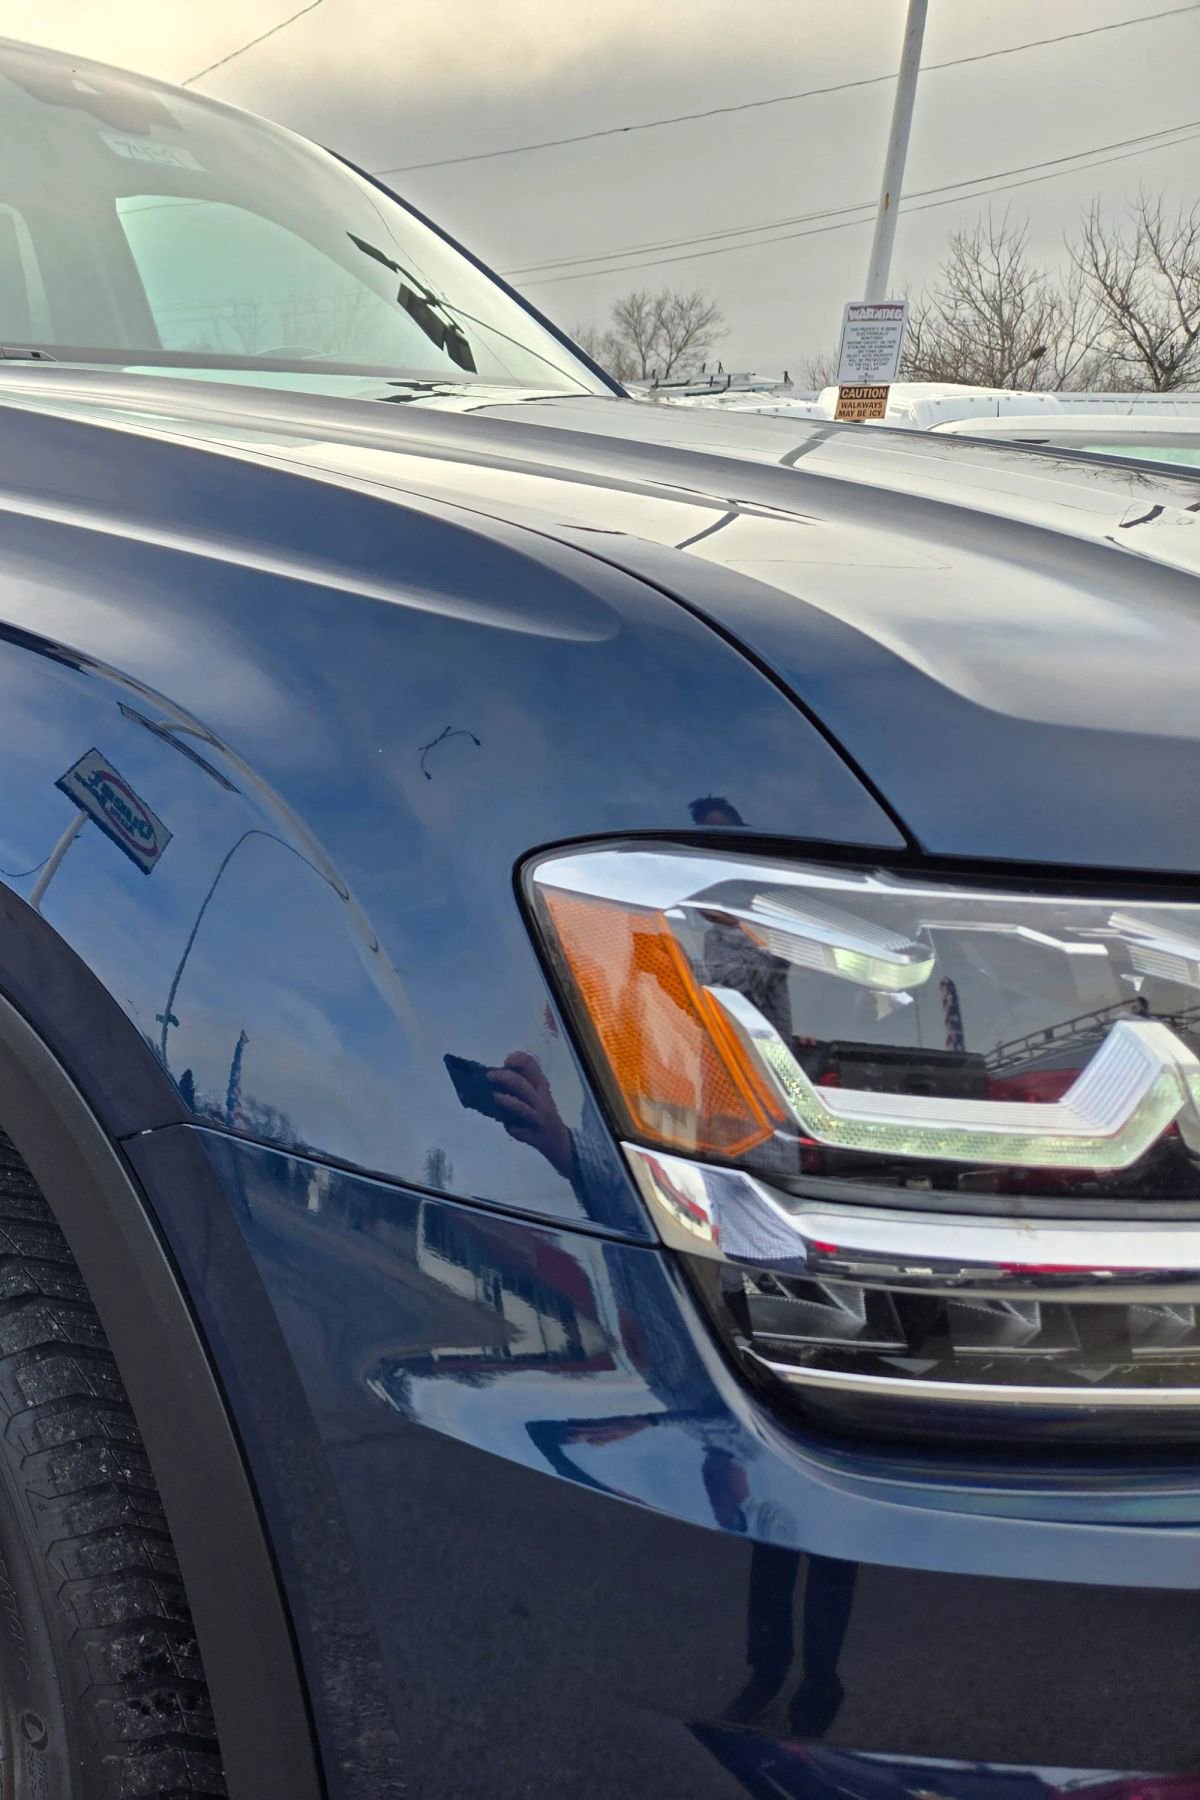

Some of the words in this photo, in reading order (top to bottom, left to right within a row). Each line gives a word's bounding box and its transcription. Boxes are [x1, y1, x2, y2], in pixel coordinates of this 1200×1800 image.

[848, 307, 903, 321] WARNING
[841, 388, 887, 399] CAUTION
[841, 401, 883, 409] WALKWAYS
